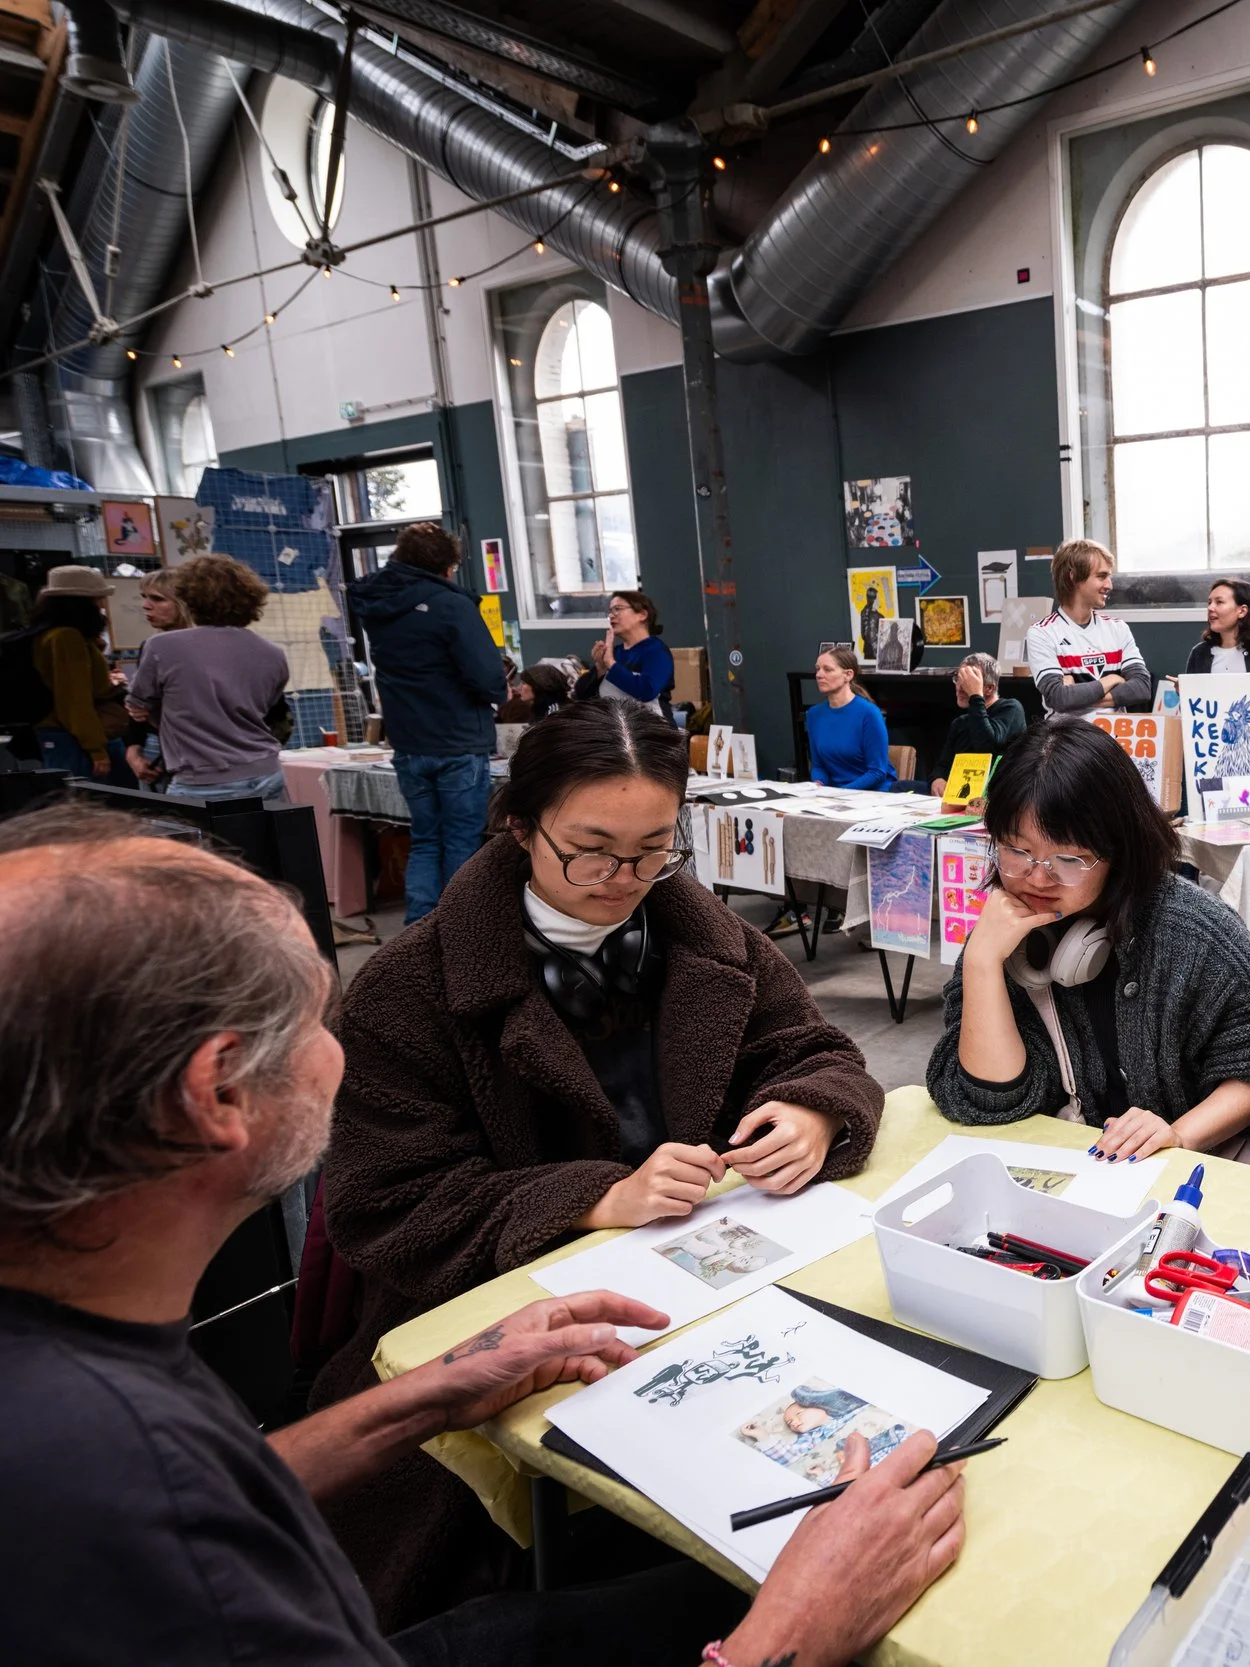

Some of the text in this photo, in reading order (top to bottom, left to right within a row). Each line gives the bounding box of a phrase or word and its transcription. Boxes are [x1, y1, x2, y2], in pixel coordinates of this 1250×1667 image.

[1083, 656, 1105, 665] SPFC
[1188, 697, 1218, 719] KU
[1192, 720, 1219, 740] KE
[1115, 738, 1156, 758] BA
[1194, 741, 1219, 758] LE
